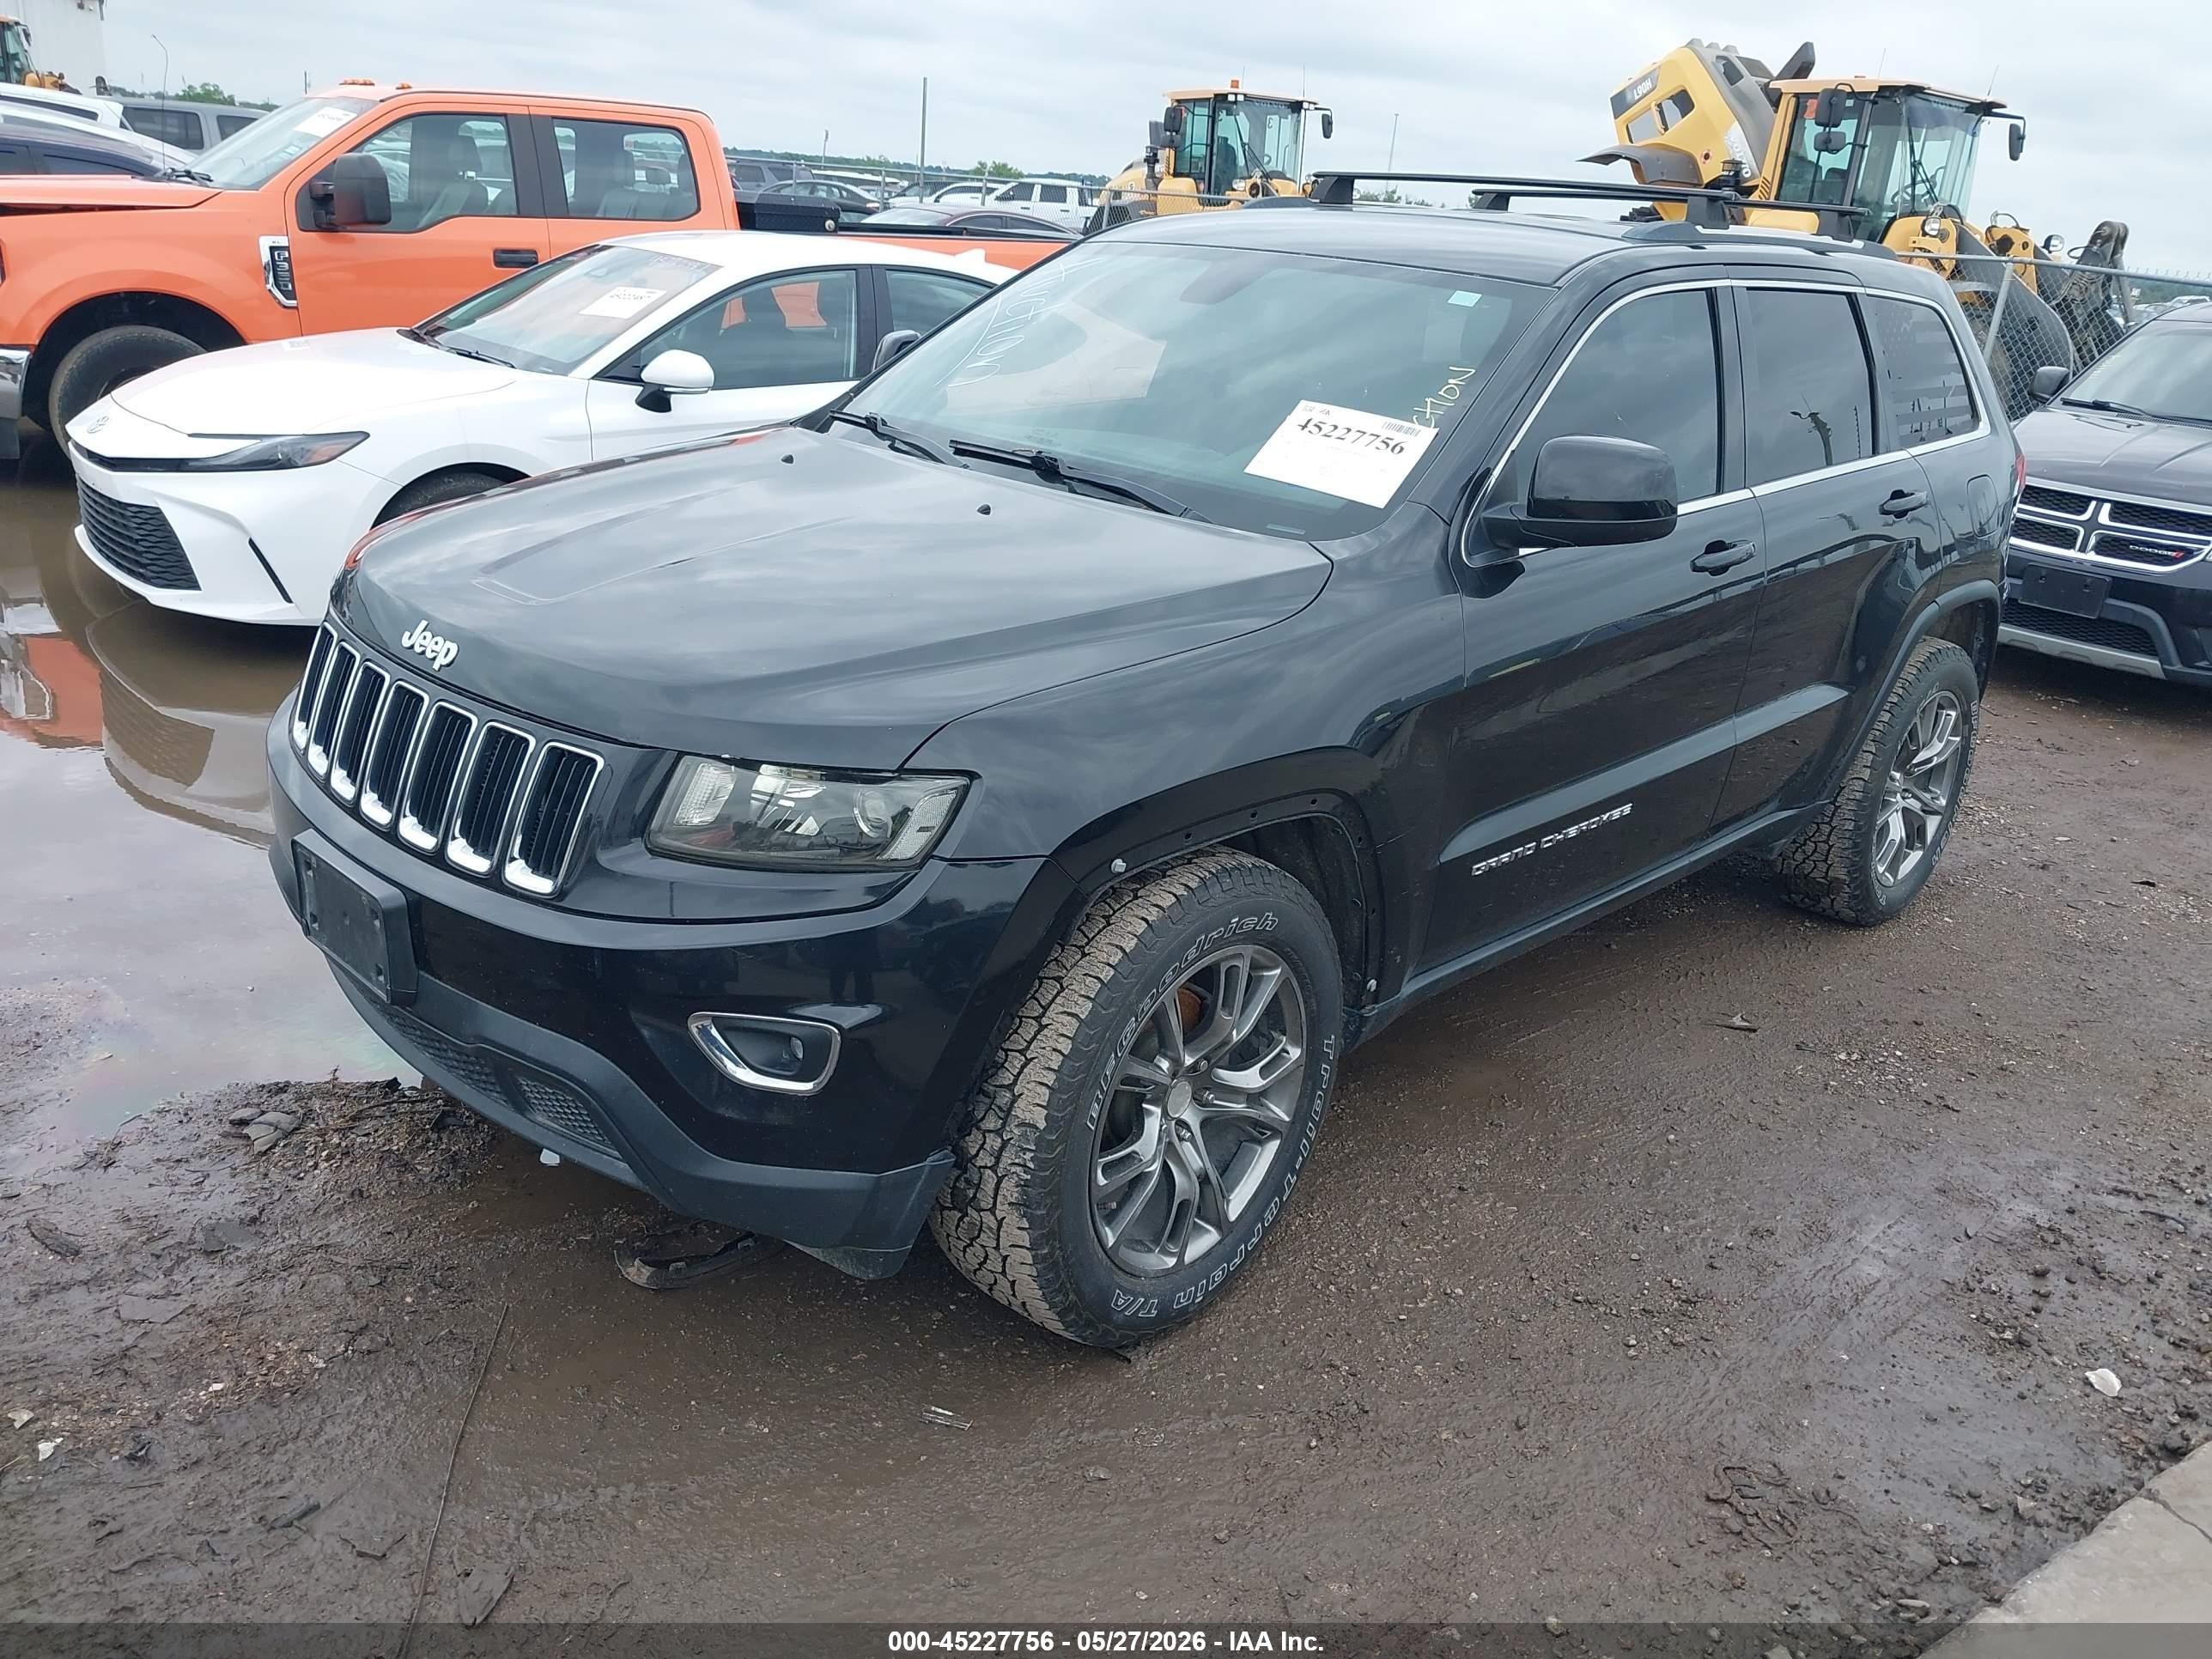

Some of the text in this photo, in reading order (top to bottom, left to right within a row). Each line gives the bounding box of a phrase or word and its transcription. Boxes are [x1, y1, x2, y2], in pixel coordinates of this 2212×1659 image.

[1634, 77, 1652, 100] L90H
[1297, 417, 1409, 455] 45227756
[2130, 544, 2175, 556] DODGE
[401, 619, 459, 672] Jeep
[1472, 803, 1633, 876] GRAND CHEROKEE
[1110, 1289, 1158, 1317] T/A
